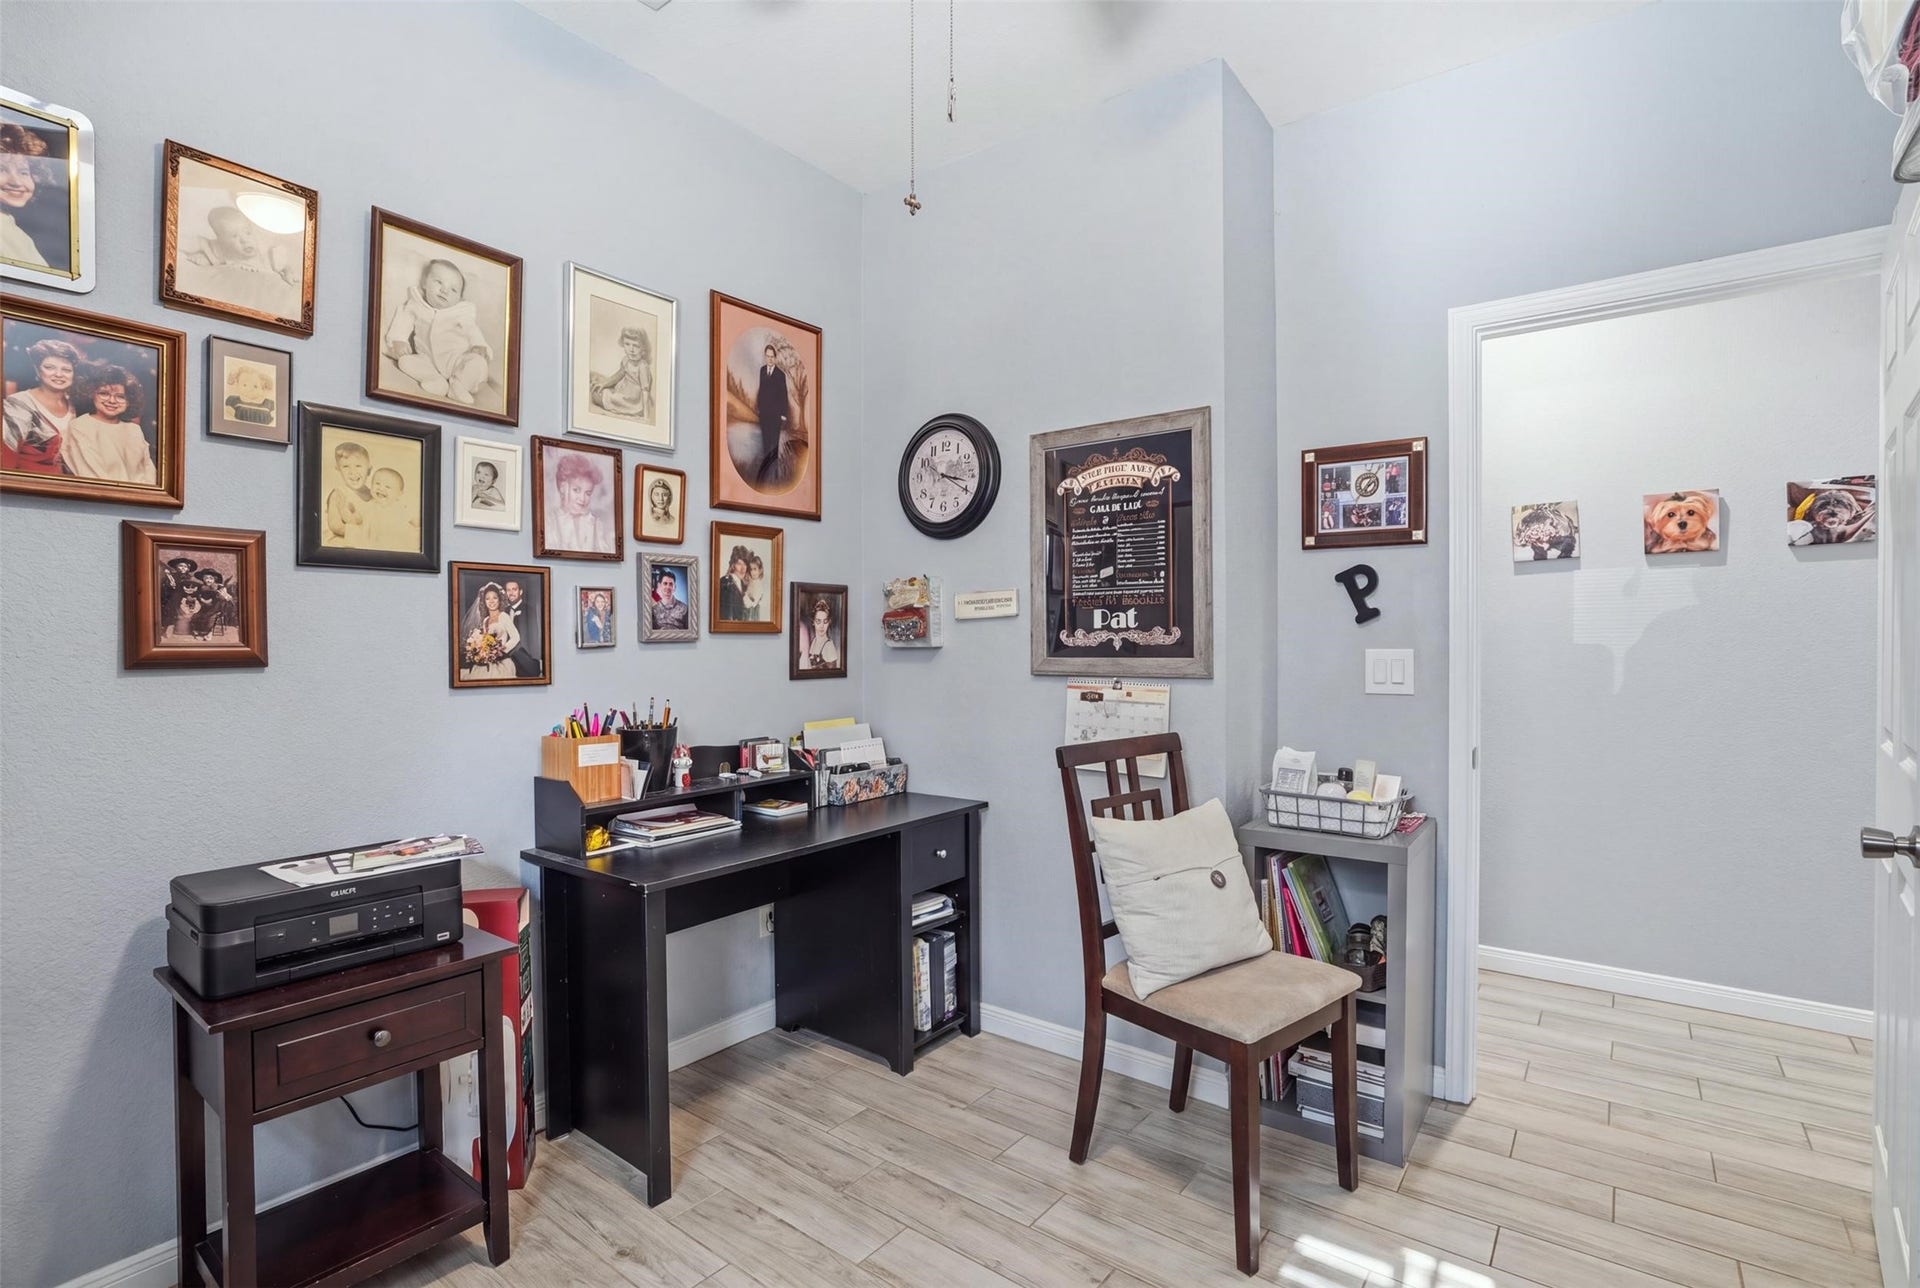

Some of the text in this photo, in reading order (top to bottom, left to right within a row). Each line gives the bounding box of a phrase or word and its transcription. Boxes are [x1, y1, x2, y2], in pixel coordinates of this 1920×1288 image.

[931, 445, 937, 457] 11
[941, 441, 951, 452] 12
[921, 458, 930, 469] 10
[963, 453, 971, 464] 2
[916, 473, 923, 483] 9
[920, 489, 927, 499] 8
[929, 497, 935, 508] 7
[940, 501, 947, 512] 6
[953, 497, 960, 508] 5
[1335, 564, 1381, 624] P
[1093, 607, 1139, 629] Pat
